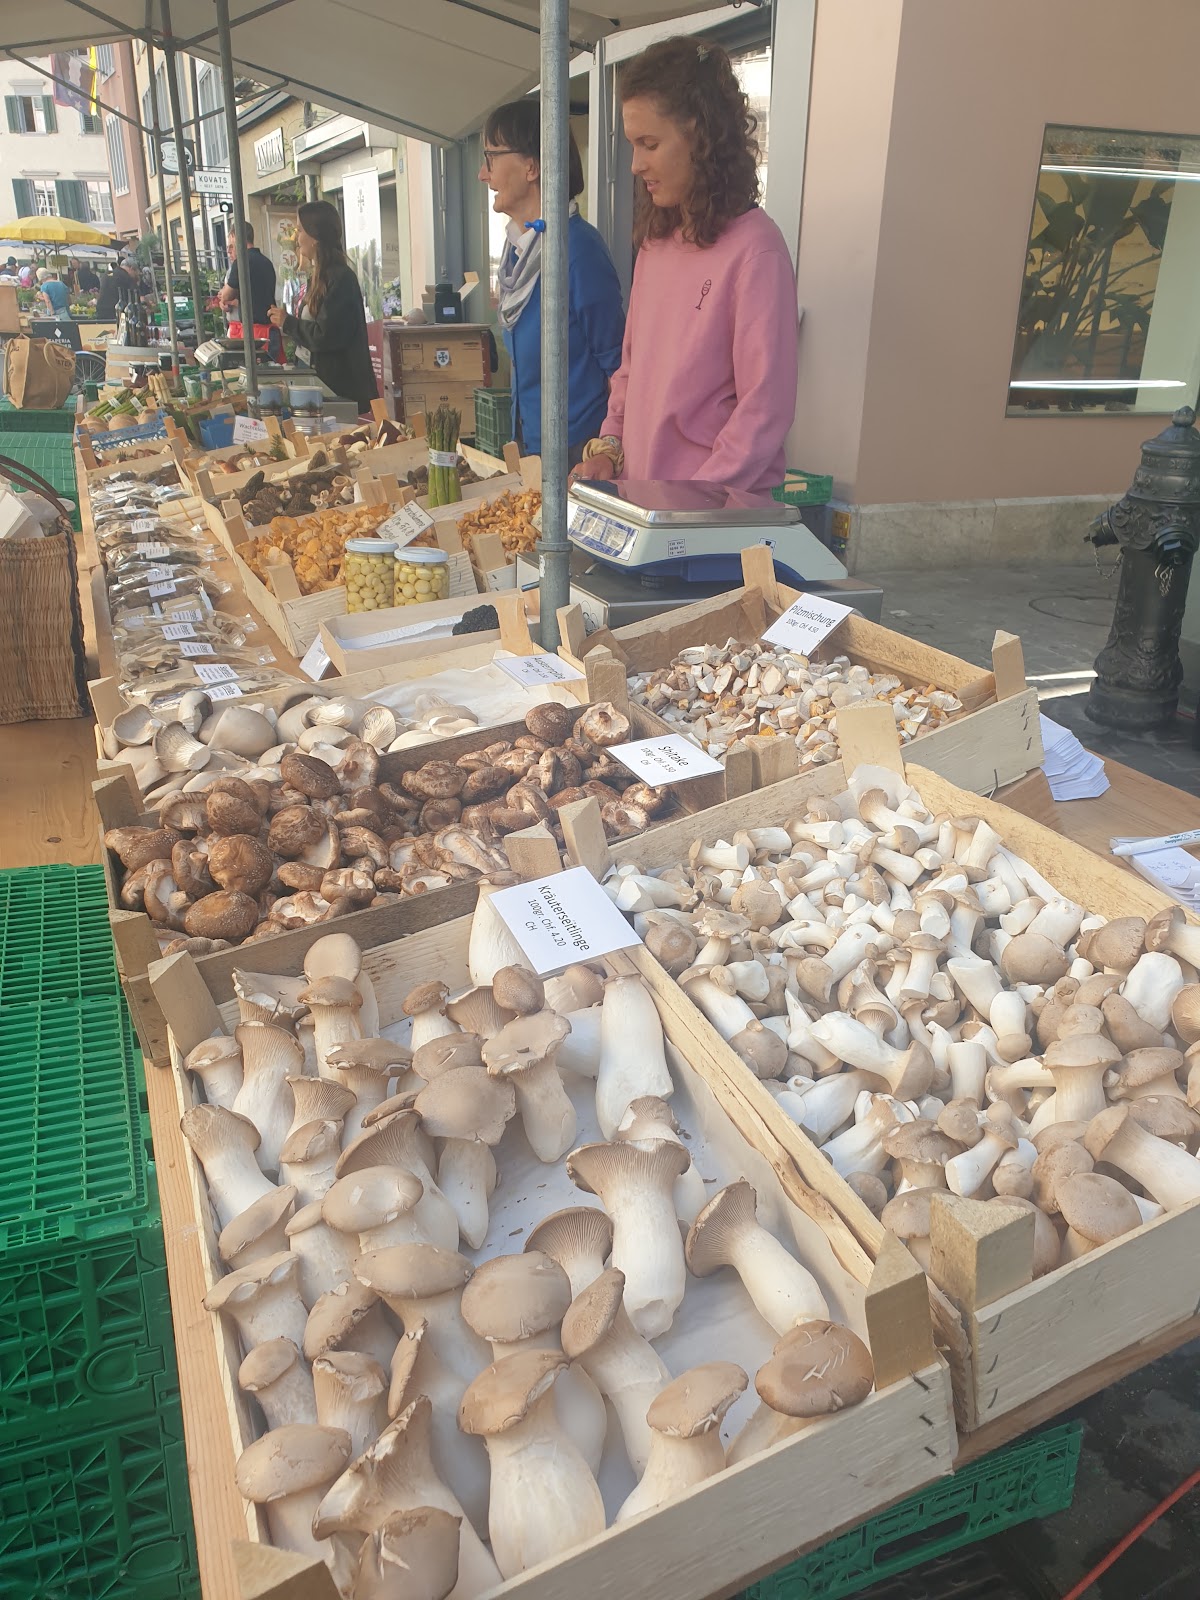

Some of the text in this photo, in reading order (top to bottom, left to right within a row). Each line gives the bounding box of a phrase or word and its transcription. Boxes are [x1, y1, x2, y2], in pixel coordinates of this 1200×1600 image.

[199, 175, 228, 184] KOVATS
[789, 605, 836, 628] Pilzmischung
[658, 745, 689, 767] Shitake
[525, 920, 538, 932] CH
[527, 898, 567, 947] 100gr. Chf. 4.20
[538, 885, 590, 951] Kräuterseitlinge
